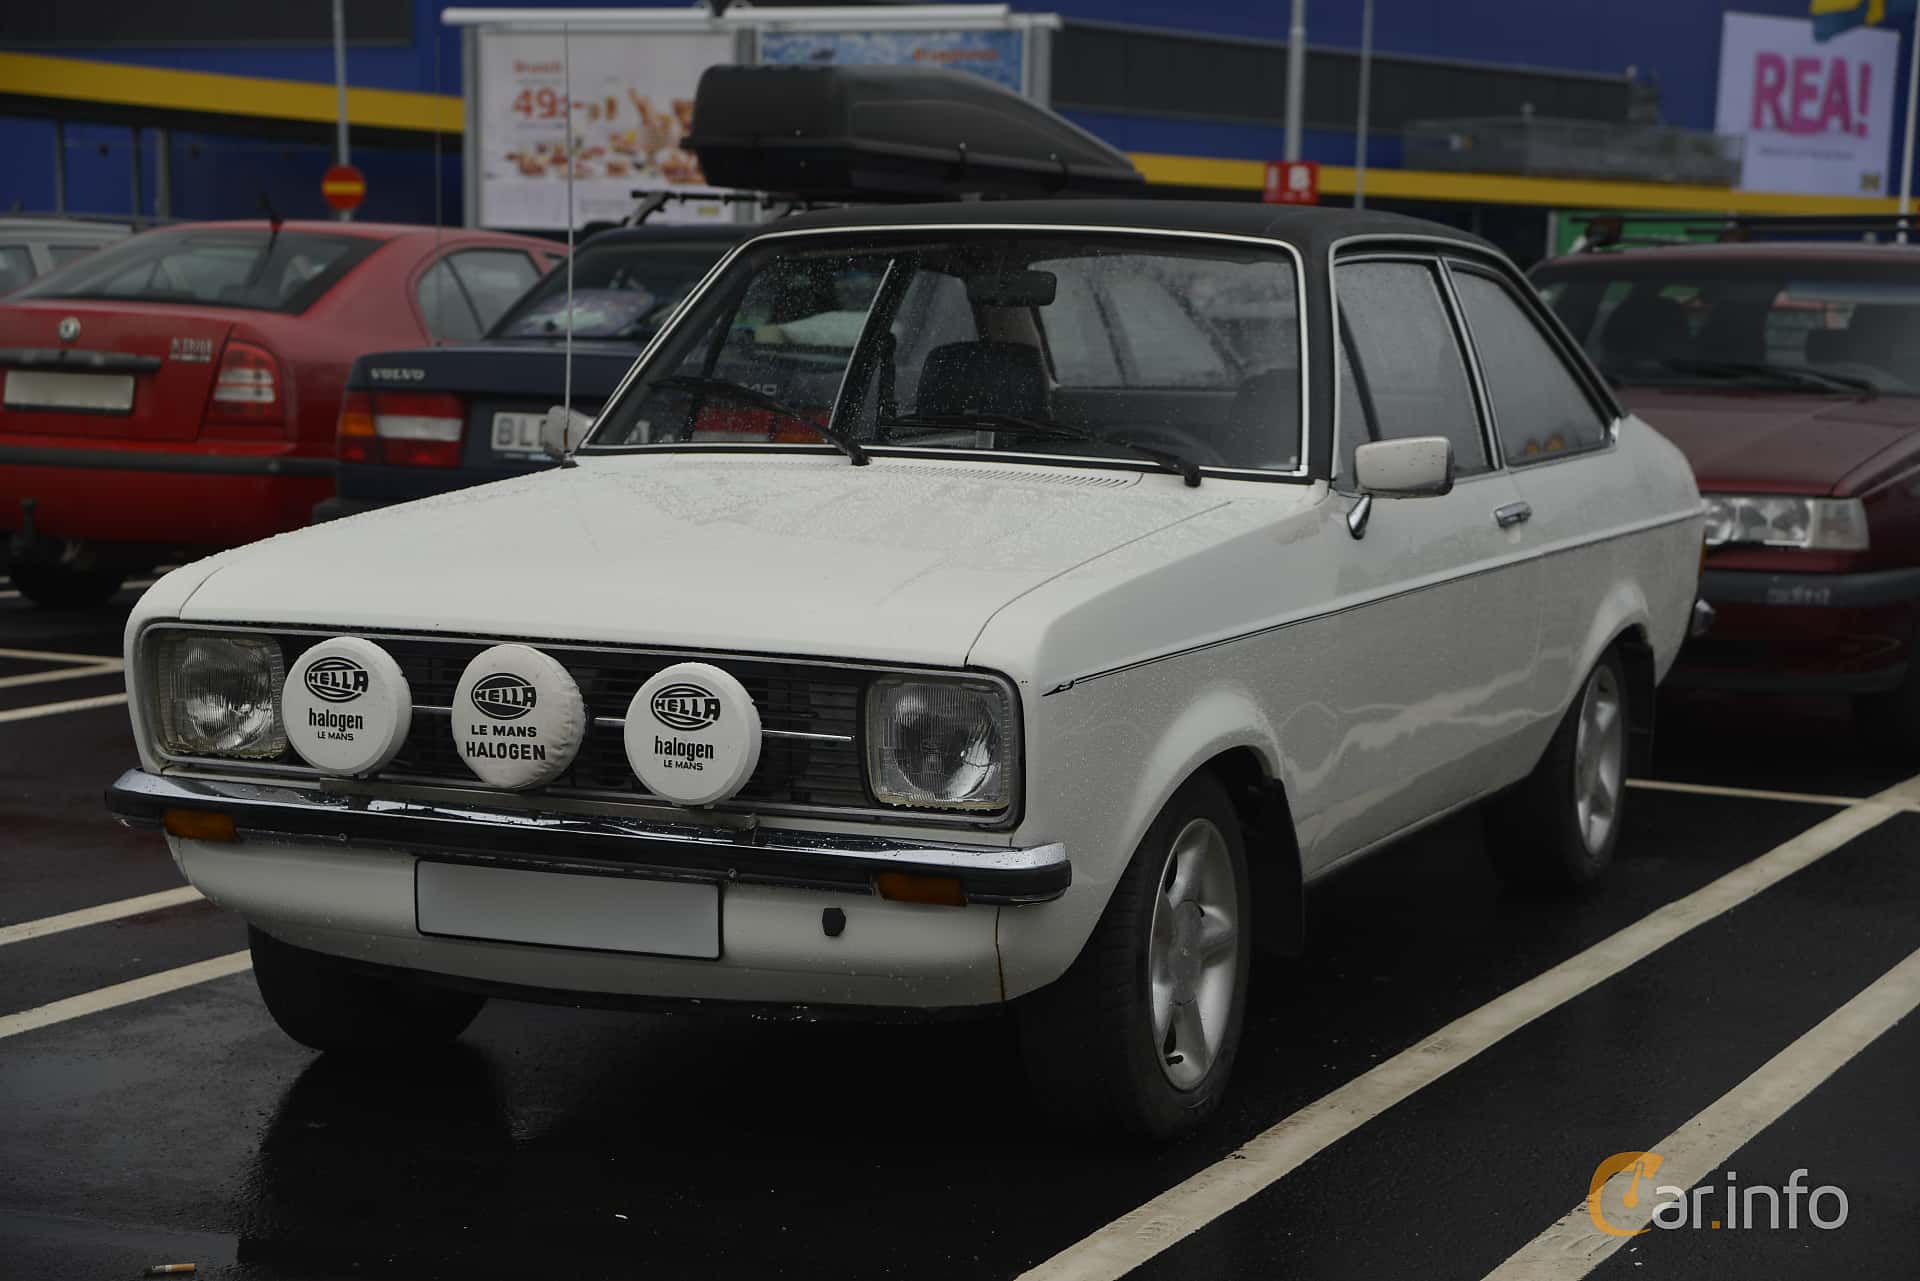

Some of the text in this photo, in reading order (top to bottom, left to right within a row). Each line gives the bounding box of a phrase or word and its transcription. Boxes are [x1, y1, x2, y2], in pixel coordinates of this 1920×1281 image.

[1751, 51, 1872, 138] REA!
[370, 367, 426, 381] VOLVO
[308, 670, 368, 692] HELLA
[475, 686, 536, 708] HELLA
[309, 707, 363, 732] halogen
[655, 698, 720, 721] HELLA
[317, 731, 354, 741] LE MANS
[471, 724, 536, 737] LE MANS
[466, 741, 545, 760] HALOGEN
[654, 735, 714, 761] halogen
[663, 759, 703, 770] LE MANS
